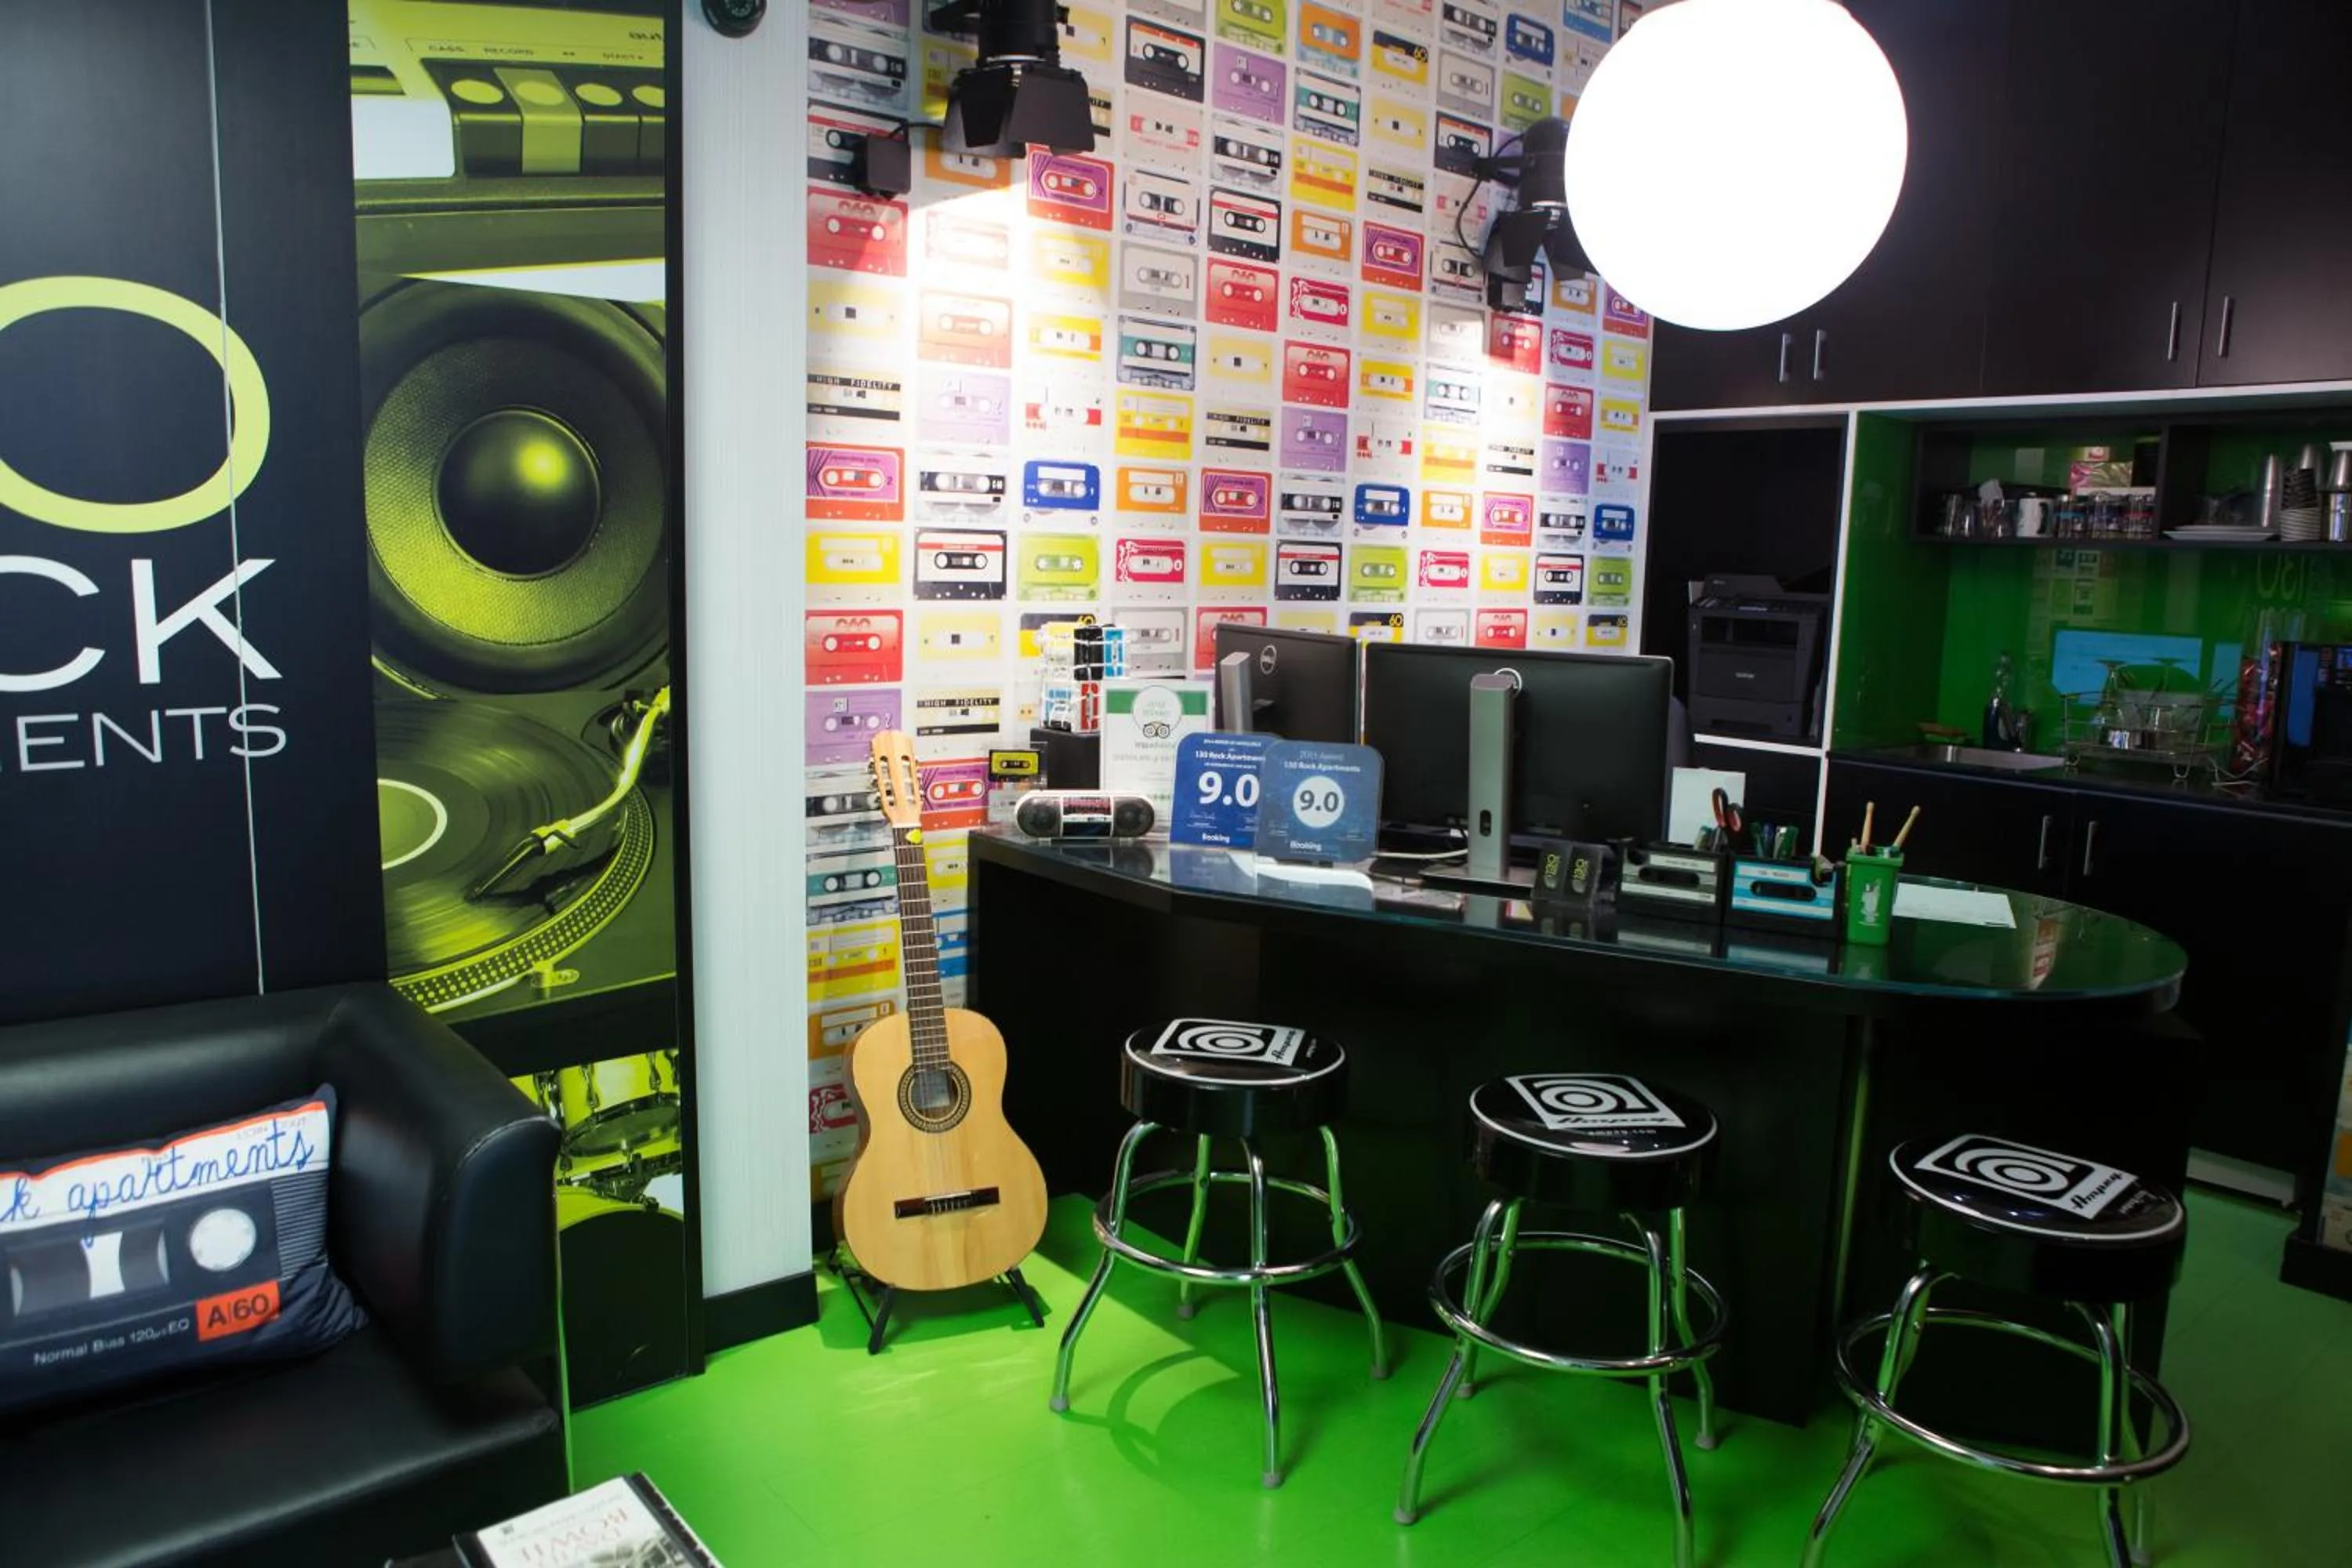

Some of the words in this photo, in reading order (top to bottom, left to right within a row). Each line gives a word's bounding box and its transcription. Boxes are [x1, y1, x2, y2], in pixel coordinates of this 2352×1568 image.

[1388, 614, 1403, 627] 60
[0, 703, 287, 772] ENTS
[1198, 771, 1260, 808] 9.0
[1299, 789, 1339, 812] 9.0
[67, 1118, 314, 1248] apartments
[2070, 1171, 2123, 1209] Ampeg
[34, 1346, 89, 1366] Normal
[92, 1337, 126, 1354] Bias
